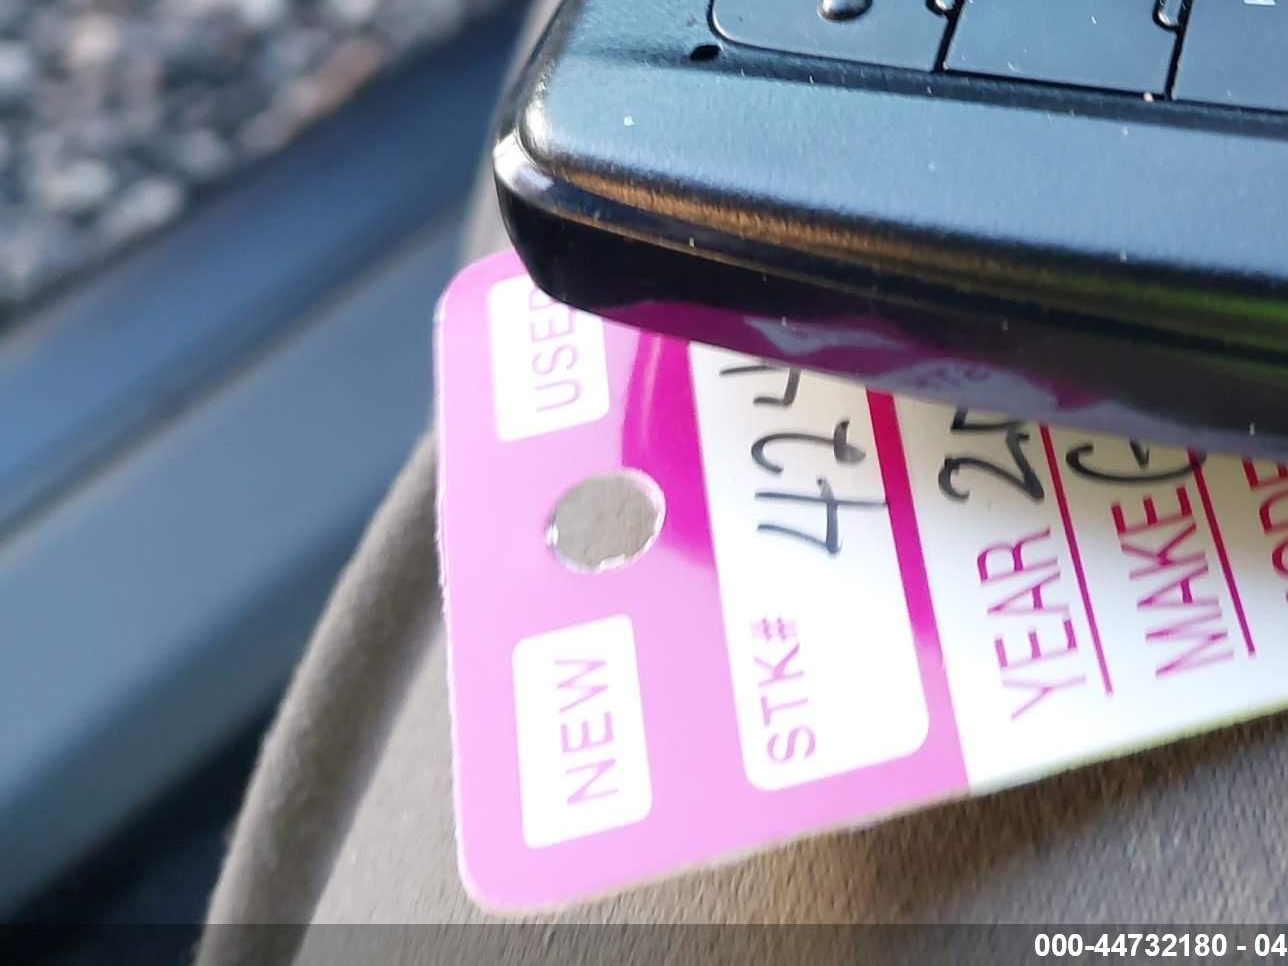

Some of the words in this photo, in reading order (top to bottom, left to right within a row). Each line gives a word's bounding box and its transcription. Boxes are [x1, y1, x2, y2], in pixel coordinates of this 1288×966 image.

[976, 527, 1086, 721] YEAR
[1111, 484, 1234, 679] MAKE
[554, 656, 620, 807] NEW
[751, 614, 817, 763] STK#
